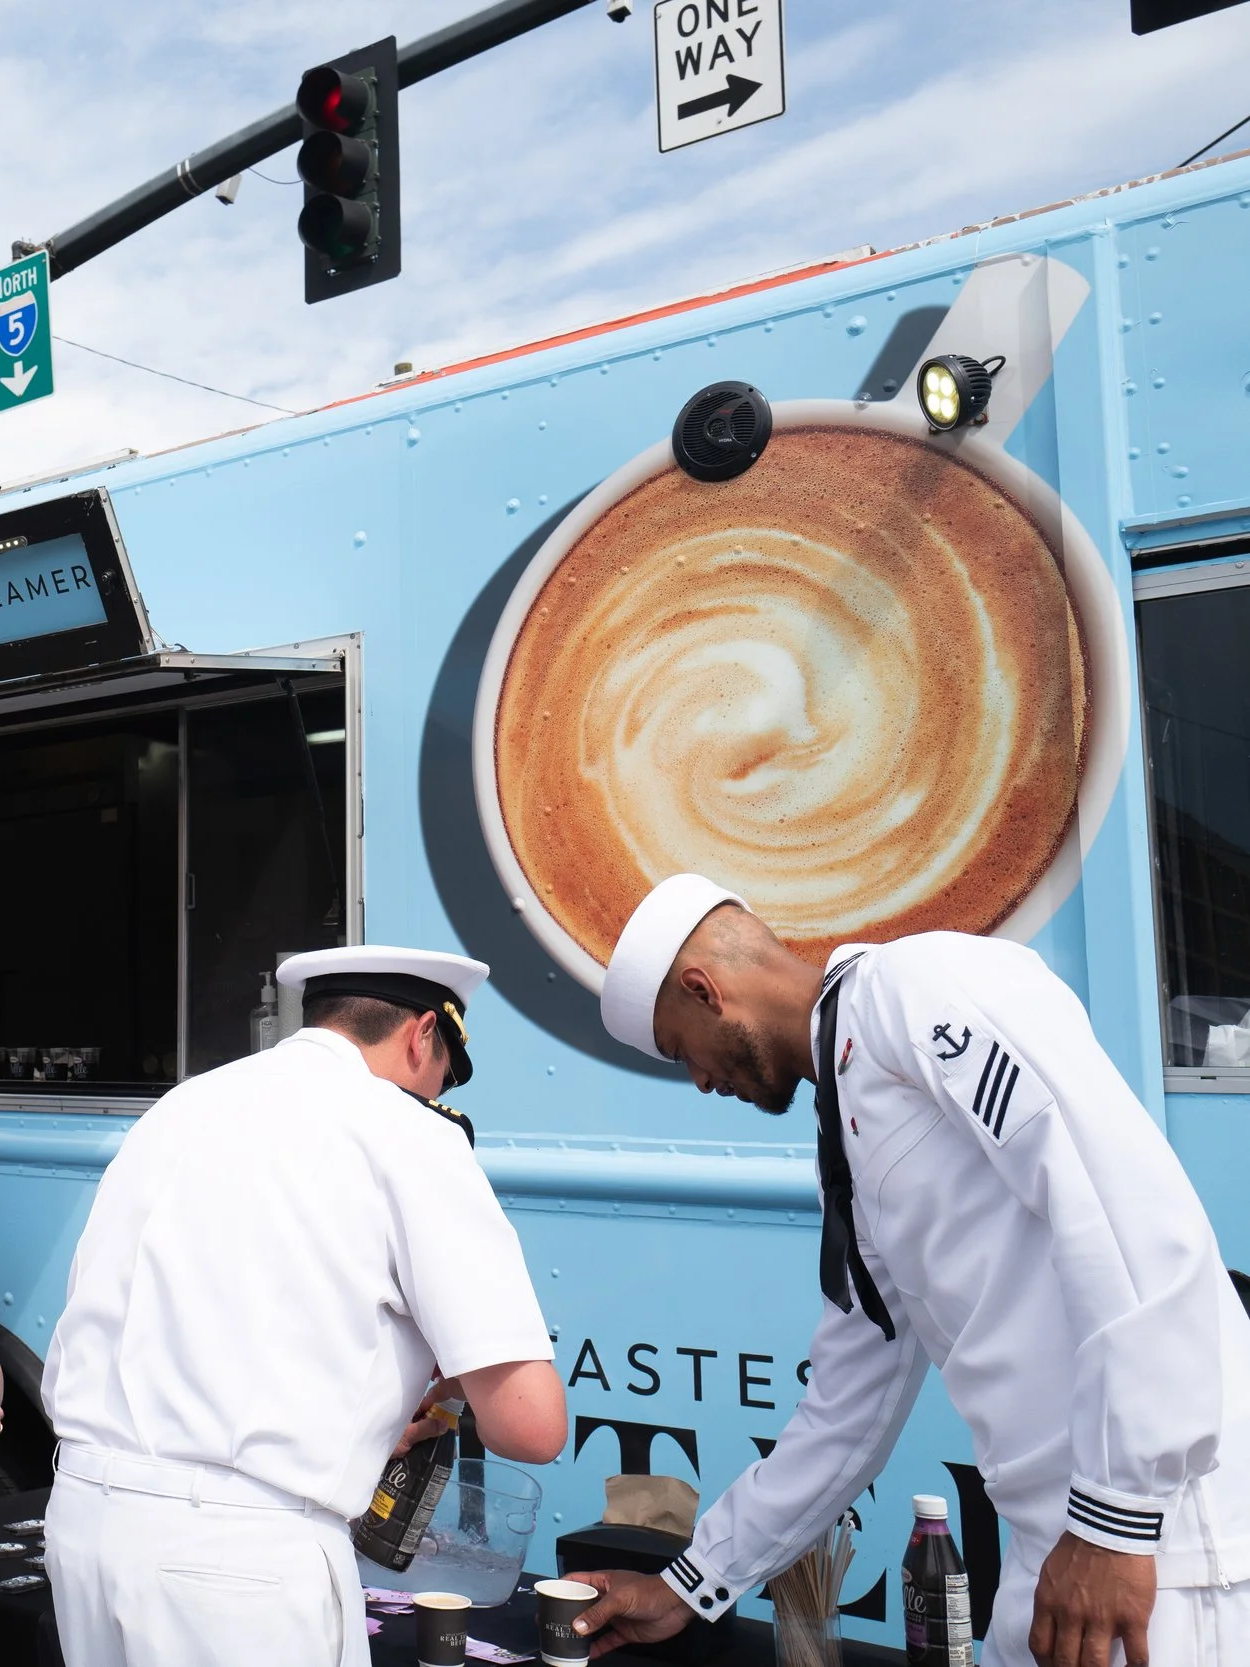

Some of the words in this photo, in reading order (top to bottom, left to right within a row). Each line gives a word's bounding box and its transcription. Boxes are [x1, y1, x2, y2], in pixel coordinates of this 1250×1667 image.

[677, 0, 759, 37] ONE
[675, 20, 762, 81] WAY
[8, 311, 25, 346] 5
[549, 1335, 812, 1410] ASTE
